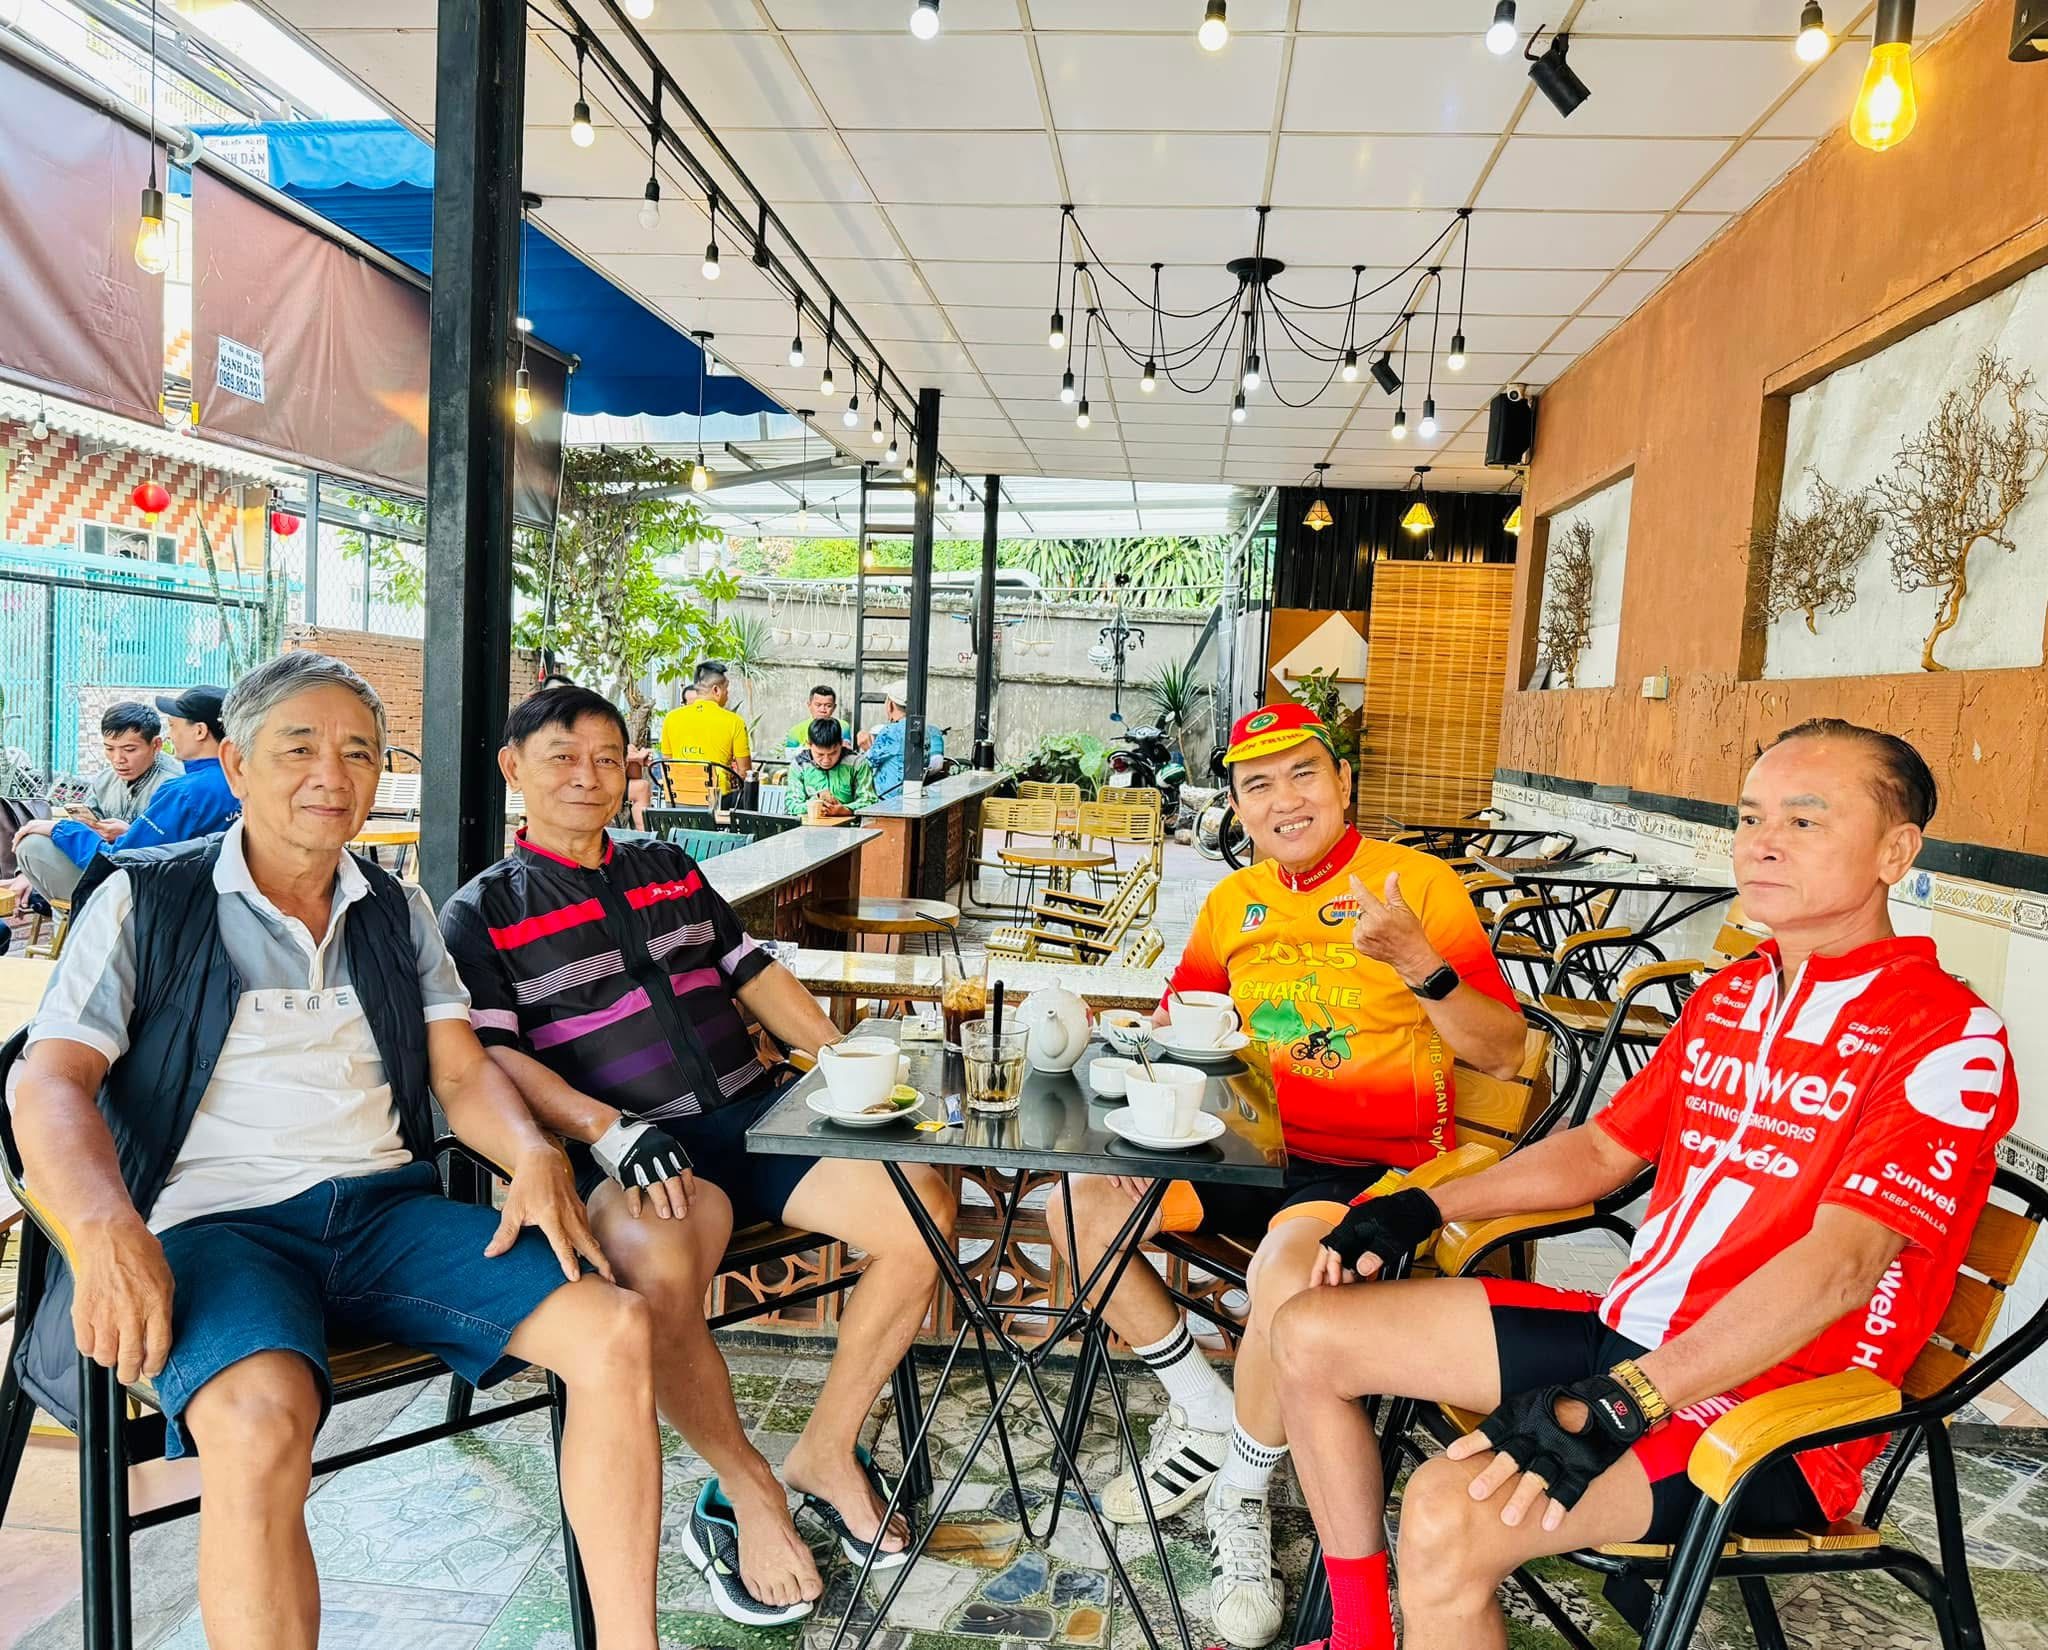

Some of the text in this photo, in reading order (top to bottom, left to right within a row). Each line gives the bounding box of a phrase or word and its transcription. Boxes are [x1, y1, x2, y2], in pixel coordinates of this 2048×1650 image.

[1303, 862, 1333, 886] CHARLIE
[1248, 941, 1357, 970] 2015
[1236, 980, 1361, 1010] CHARLIE
[1290, 1063, 1336, 1081] 2021
[1680, 1038, 1857, 1122] Sunweb
[1431, 1070, 1448, 1114] GRAN
[1680, 1129, 1800, 1179] ervélo
[1880, 1190, 1909, 1208] KEEP
[1881, 1162, 1957, 1216] Sunweb
